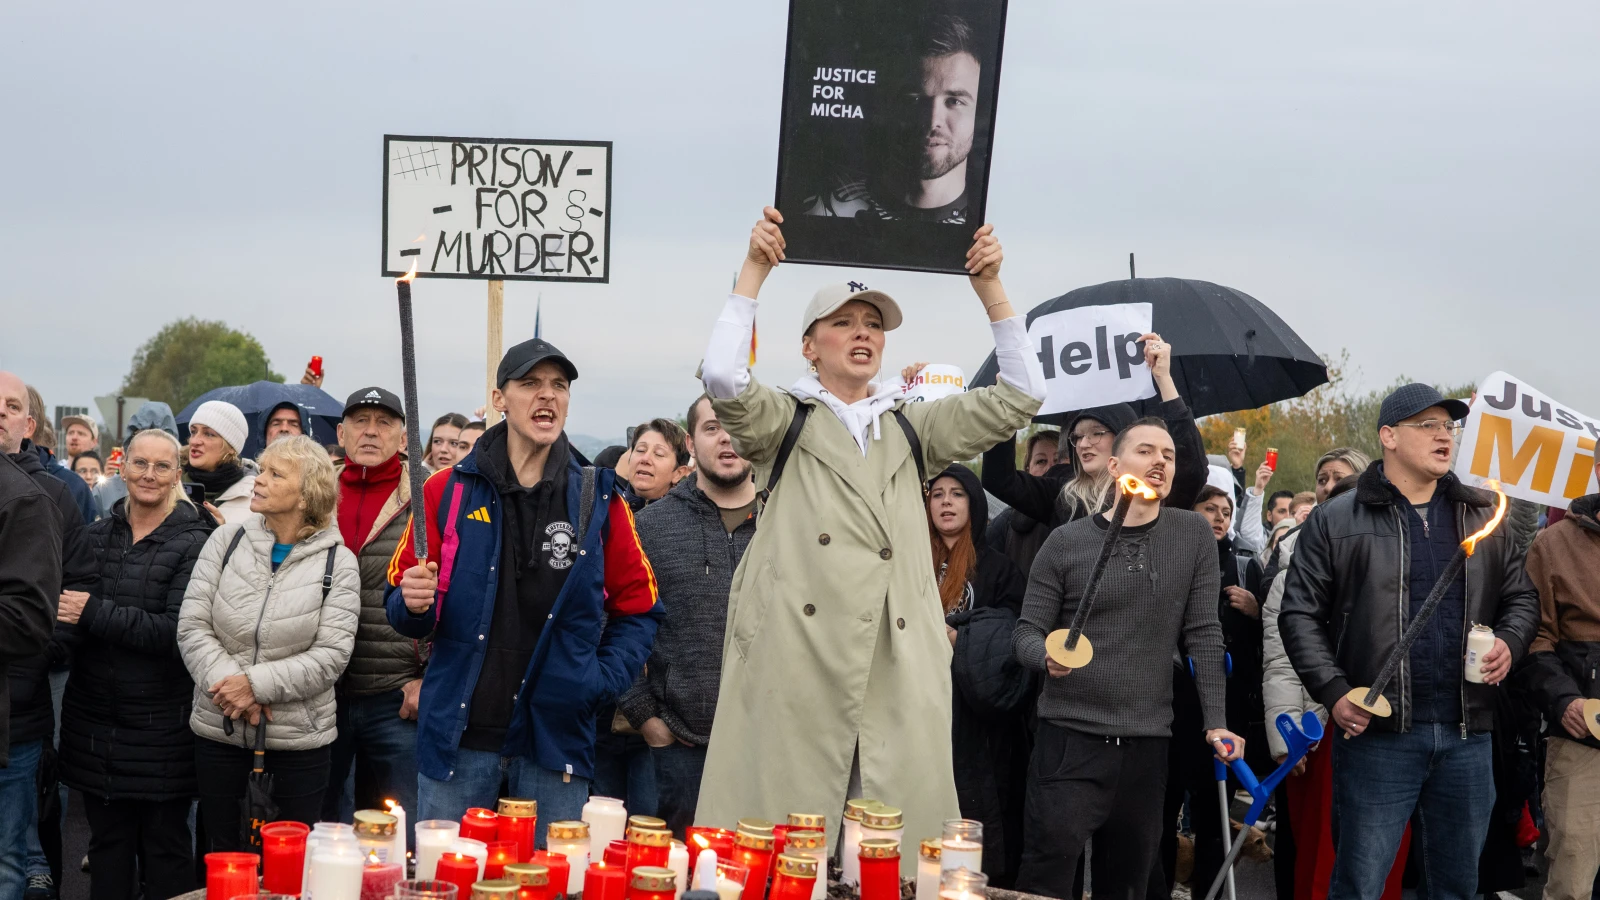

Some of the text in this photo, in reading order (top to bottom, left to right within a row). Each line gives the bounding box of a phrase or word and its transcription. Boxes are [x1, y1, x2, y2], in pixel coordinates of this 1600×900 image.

[813, 67, 877, 84] JUSTICE
[812, 85, 845, 100] FOR
[810, 103, 864, 119] MICHA
[451, 142, 573, 188] PRISON
[476, 187, 548, 230] FOR
[1037, 325, 1147, 380] Help
